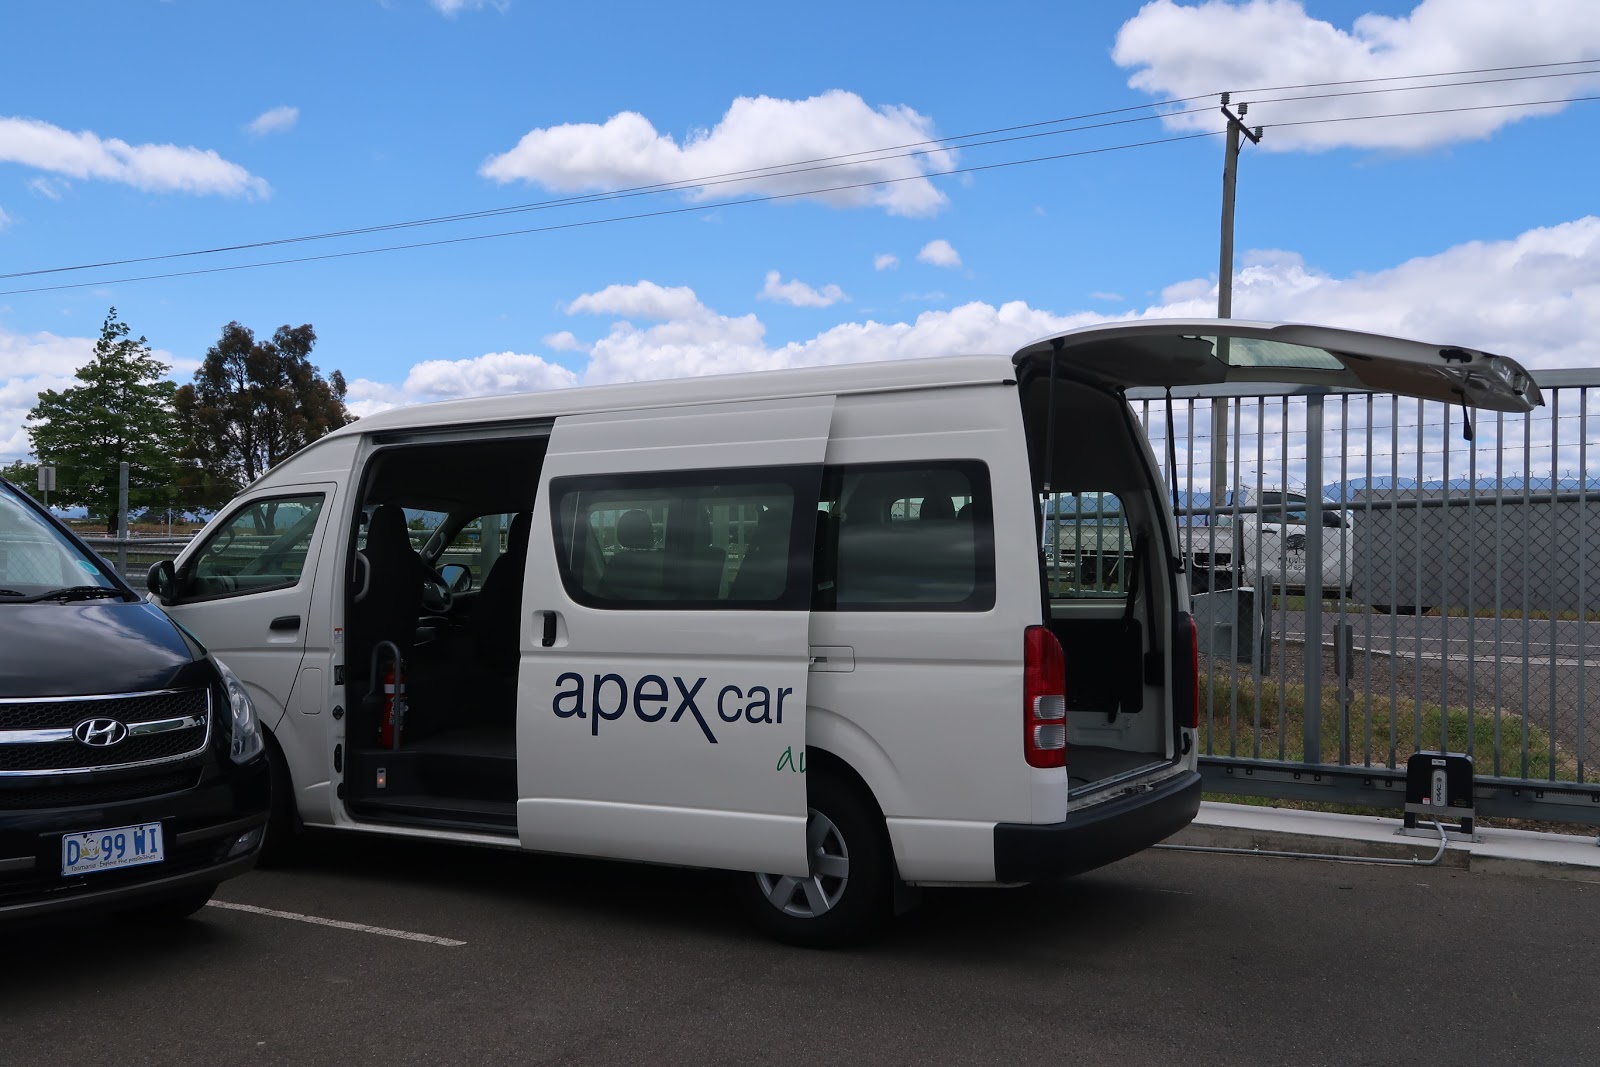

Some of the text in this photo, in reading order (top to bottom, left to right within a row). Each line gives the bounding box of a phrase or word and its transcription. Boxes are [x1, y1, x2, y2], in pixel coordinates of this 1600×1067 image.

[552, 671, 793, 744] apex car
[67, 828, 158, 866] D 99 WI
[71, 863, 96, 872] Tasmania
